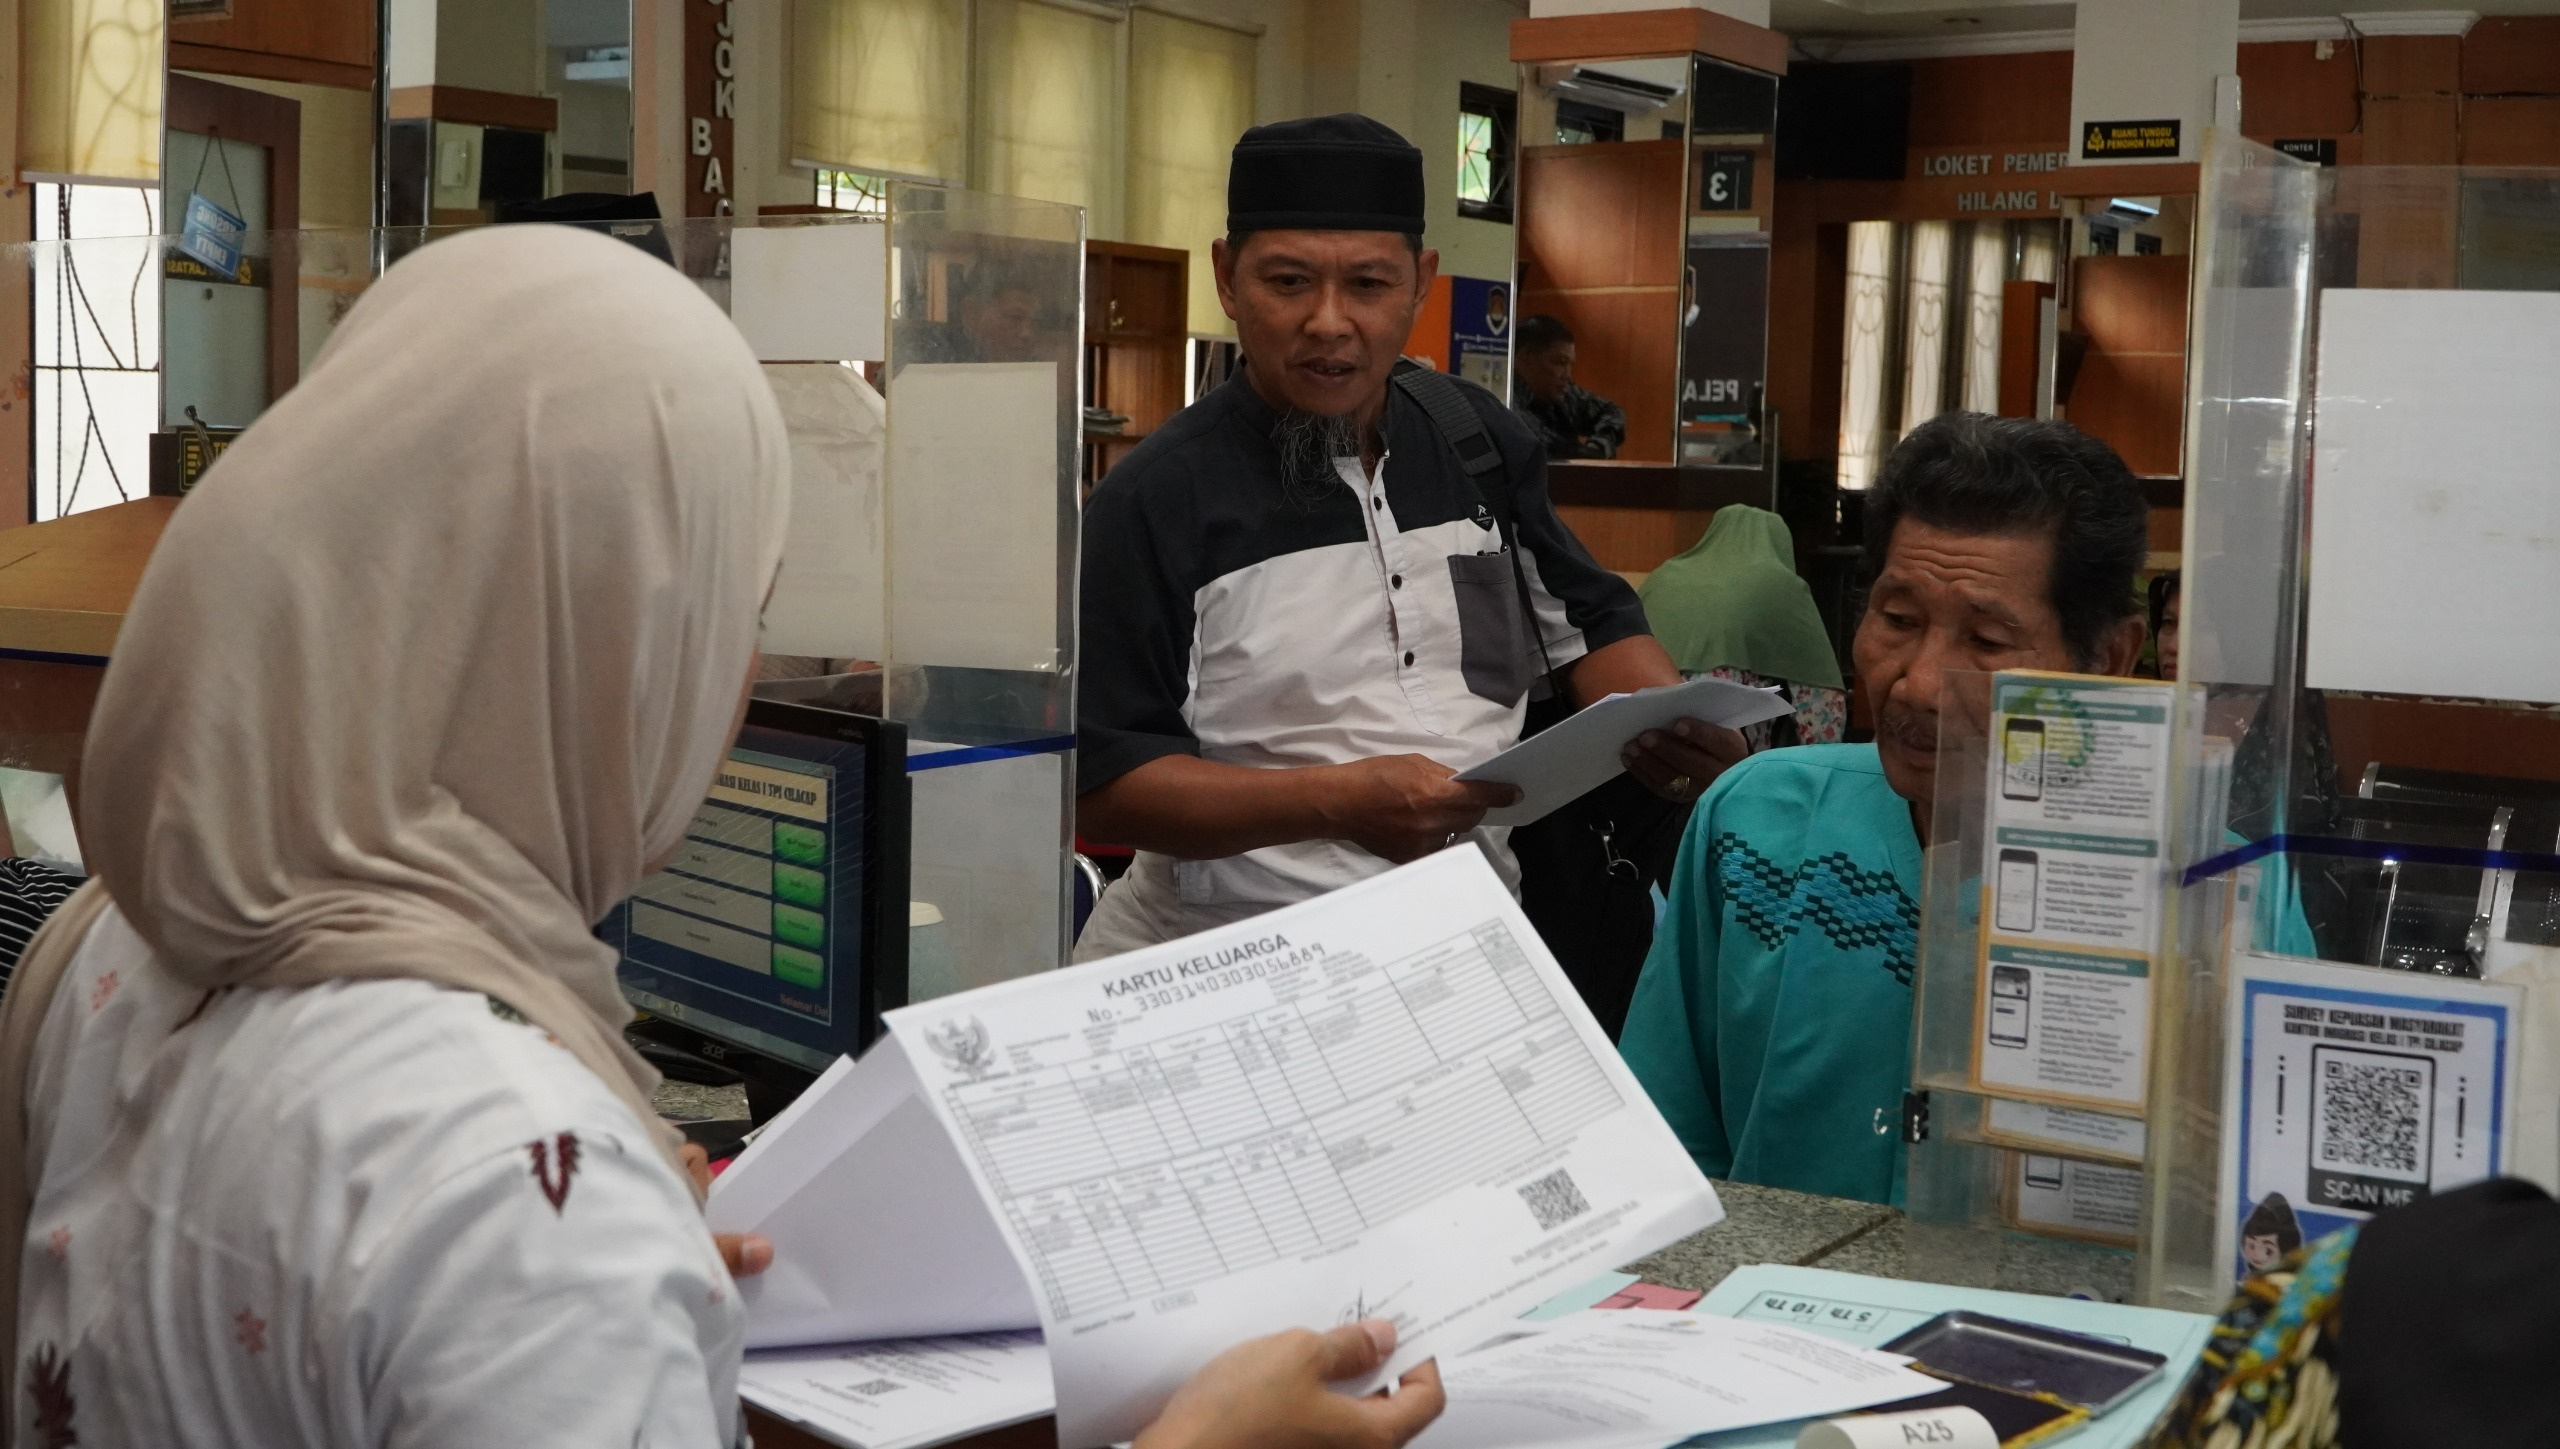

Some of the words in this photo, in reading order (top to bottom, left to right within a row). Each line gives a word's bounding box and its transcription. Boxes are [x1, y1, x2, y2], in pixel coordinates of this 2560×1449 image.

[2140, 127, 2172, 137] TUNGGU
[2145, 137, 2175, 148] PASPOR
[2283, 143, 2314, 152] KONTER
[1923, 154, 1993, 176] LOKET
[1957, 190, 2038, 211] HILANG
[738, 776, 761, 794] KELAS
[784, 787, 817, 805] CILACAP
[1102, 966, 1174, 999] KARTU
[1177, 933, 1291, 978] KELUARGA
[1087, 1007, 1122, 1023] No.
[2285, 1004, 2325, 1022] SURVEY
[2329, 1009, 2384, 1029] KEPUASAN
[2389, 1016, 2464, 1037] MASYARAKAT
[2370, 1031, 2397, 1045] KELAS
[2323, 1179, 2379, 1205] SCAN
[1791, 1302, 1817, 1314] 10
[1856, 1311, 1873, 1322] 5
[1900, 1419, 1954, 1446] A25
